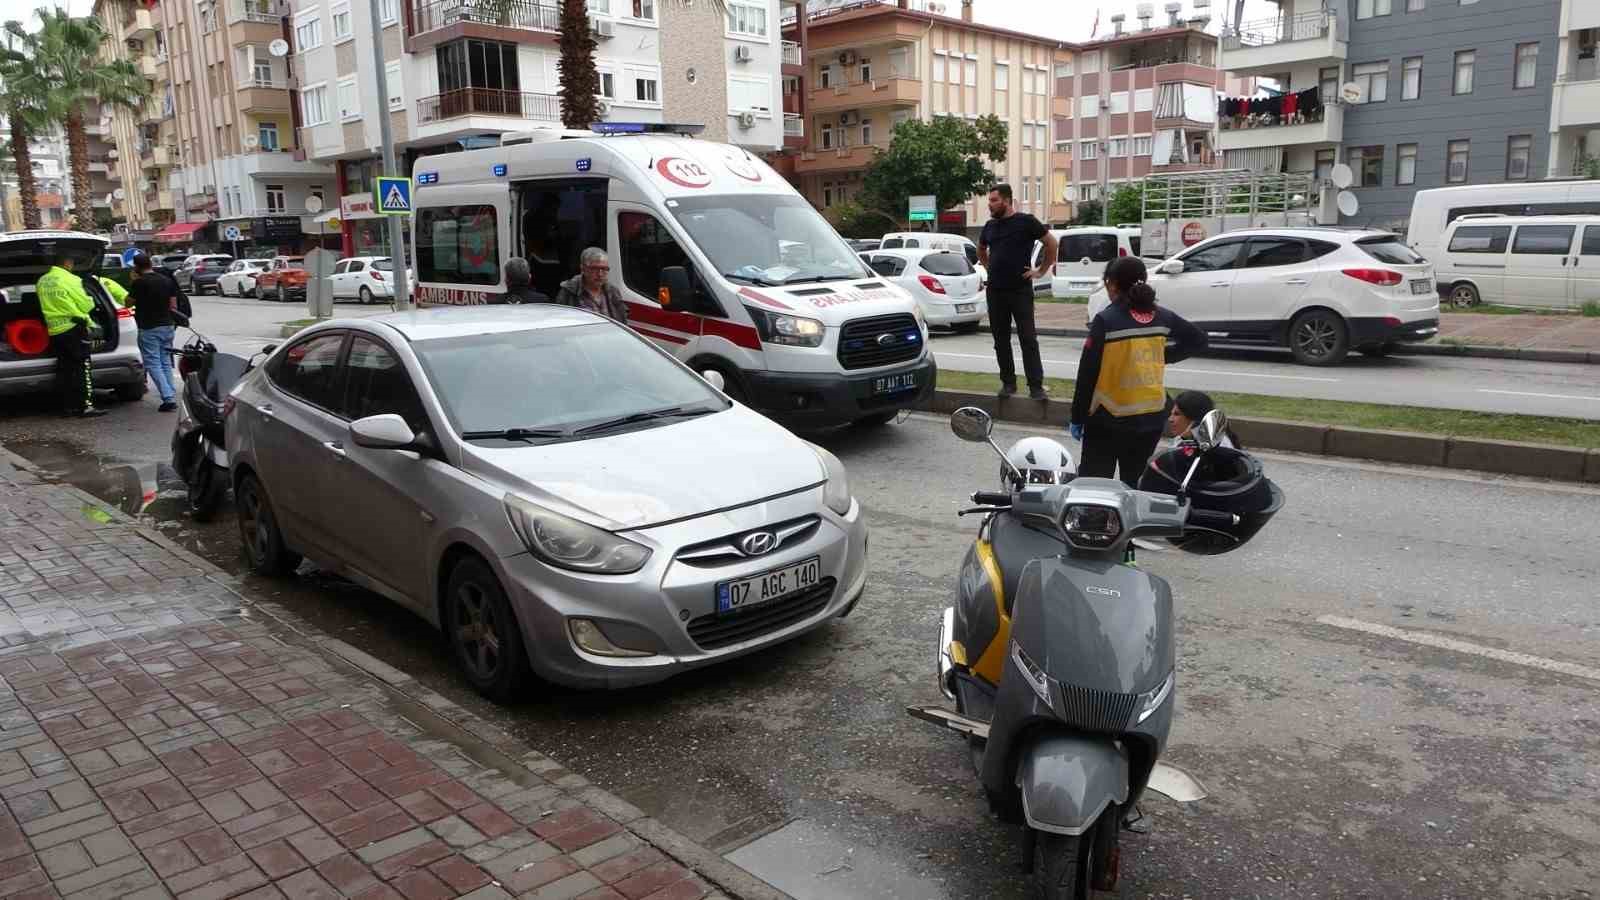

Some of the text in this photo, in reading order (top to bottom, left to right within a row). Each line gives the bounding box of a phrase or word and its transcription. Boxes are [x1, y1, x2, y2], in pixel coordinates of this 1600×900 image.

[676, 163, 707, 177] 112
[420, 287, 488, 304] AMBULANS
[731, 563, 816, 605] 07 AGC 140
